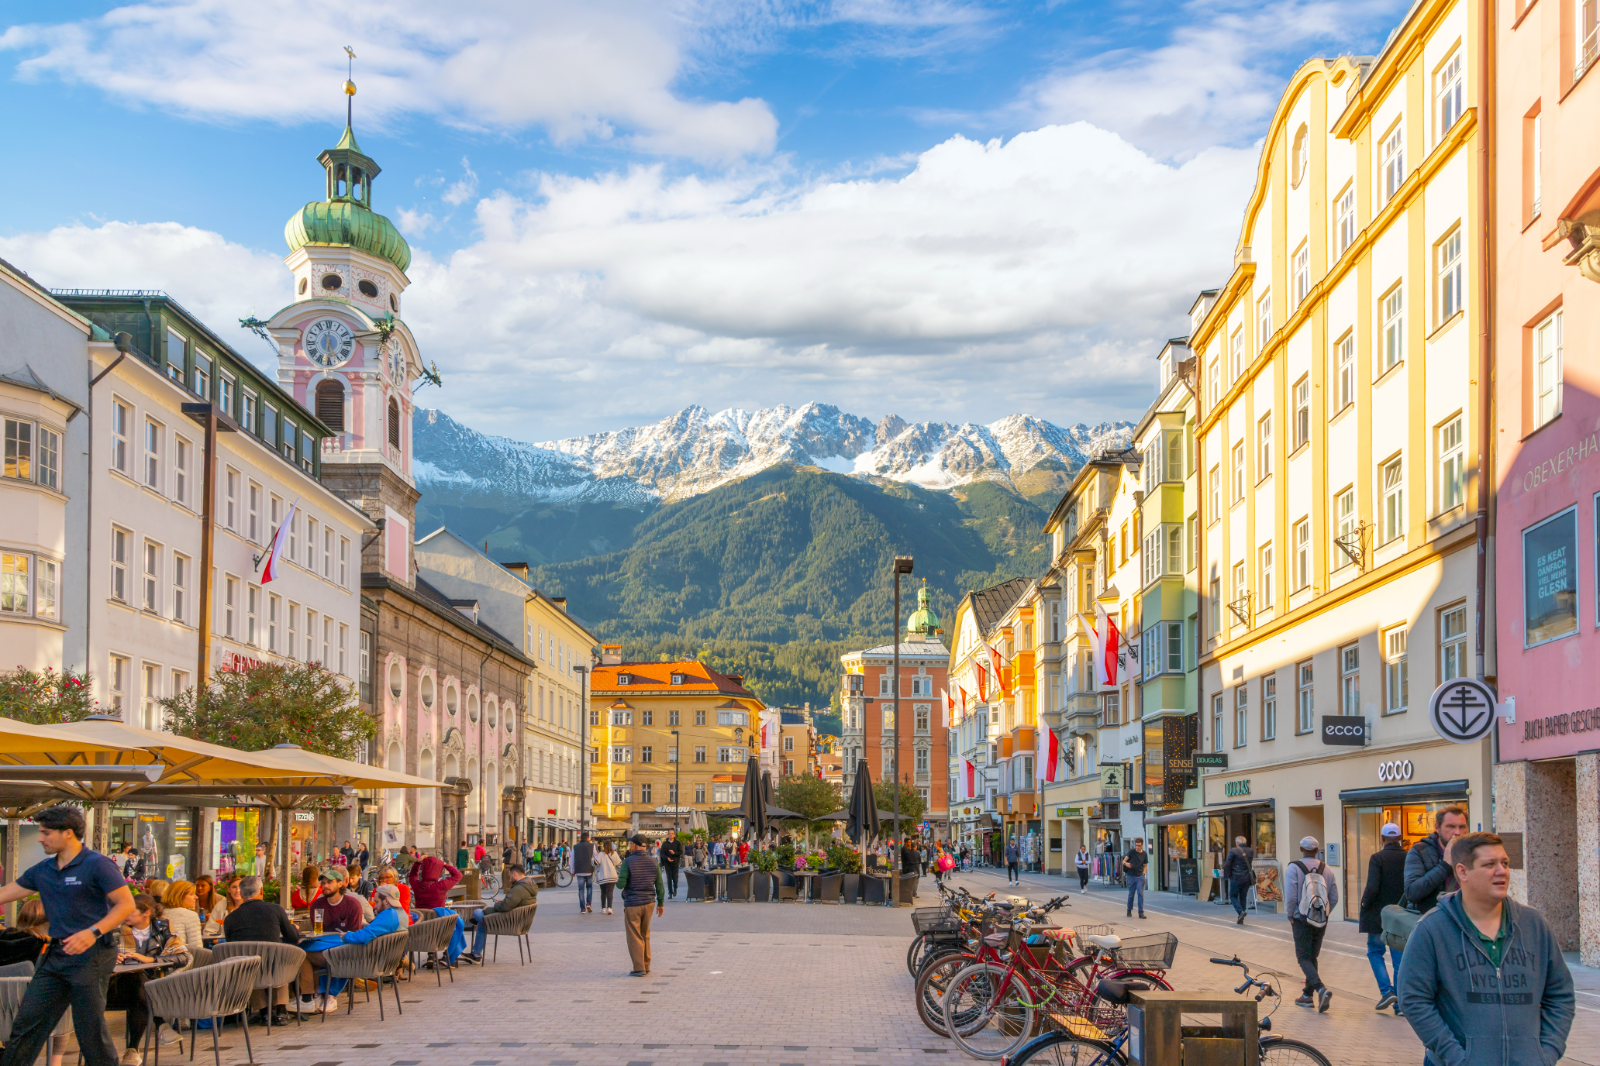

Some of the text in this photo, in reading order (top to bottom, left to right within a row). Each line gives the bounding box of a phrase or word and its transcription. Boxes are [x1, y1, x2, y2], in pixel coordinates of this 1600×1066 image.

[1523, 430, 1600, 492] OBEXER-HA
[1537, 546, 1566, 567] ES KEAT
[1538, 568, 1567, 586] VIEL MEHR
[1538, 577, 1567, 599] GLESN
[1325, 725, 1363, 736] ecco
[1524, 718, 1544, 740] BUCH
[1545, 713, 1570, 736] PAPIER
[1378, 760, 1413, 781] ecco
[1225, 779, 1250, 797] DOUGLAS
[295, 811, 314, 821] TEZENIS
[1456, 947, 1487, 971] OLD
[1472, 973, 1528, 988] NYC USA
